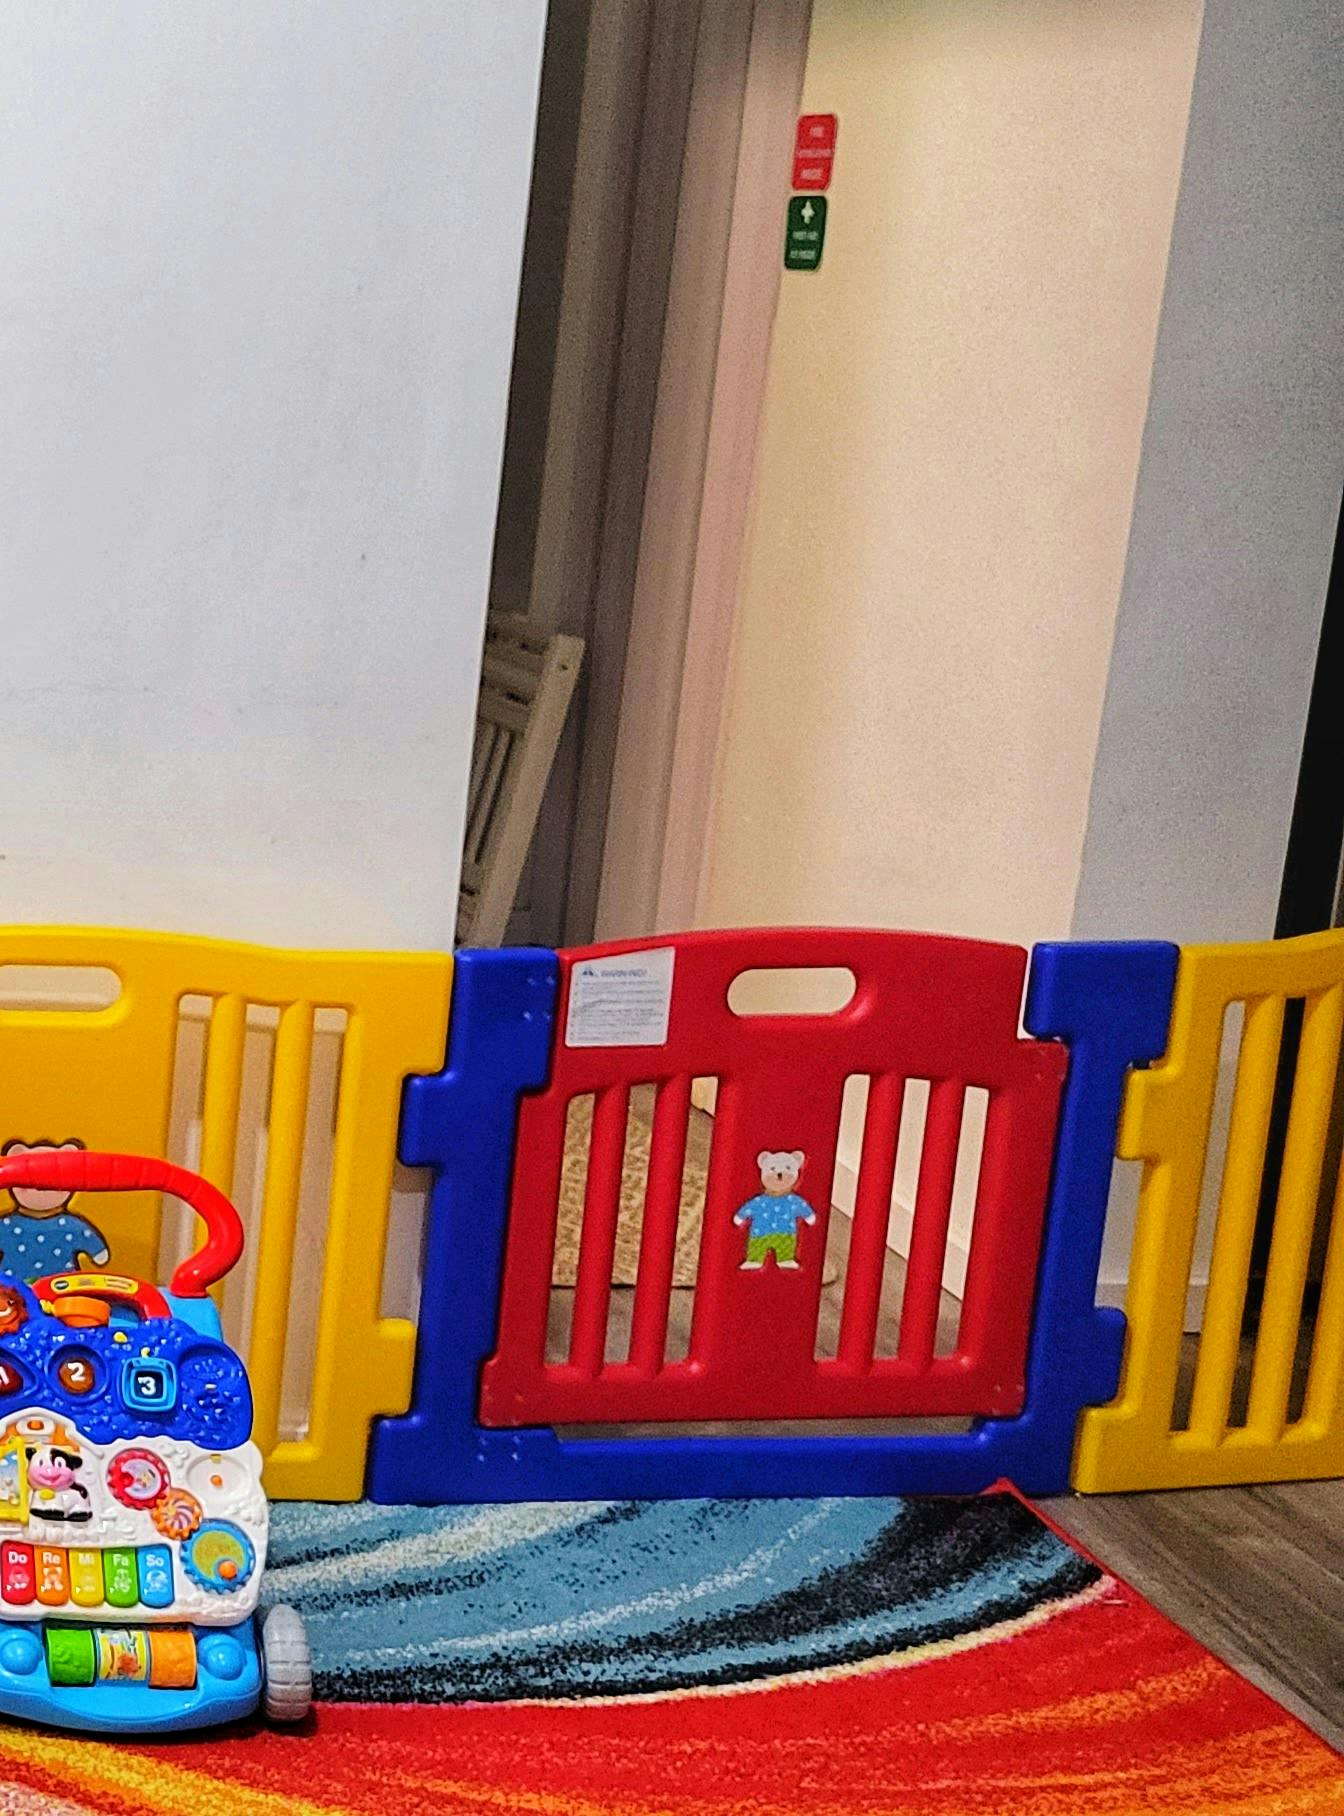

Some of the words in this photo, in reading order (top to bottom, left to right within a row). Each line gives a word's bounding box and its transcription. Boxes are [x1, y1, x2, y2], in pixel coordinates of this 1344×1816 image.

[67, 1362, 86, 1382] 2
[138, 1376, 157, 1395] 3
[8, 1551, 28, 1565] Do
[42, 1552, 61, 1565] Re
[78, 1553, 95, 1566] Mi
[113, 1553, 129, 1567] Fa
[146, 1554, 165, 1567] So
